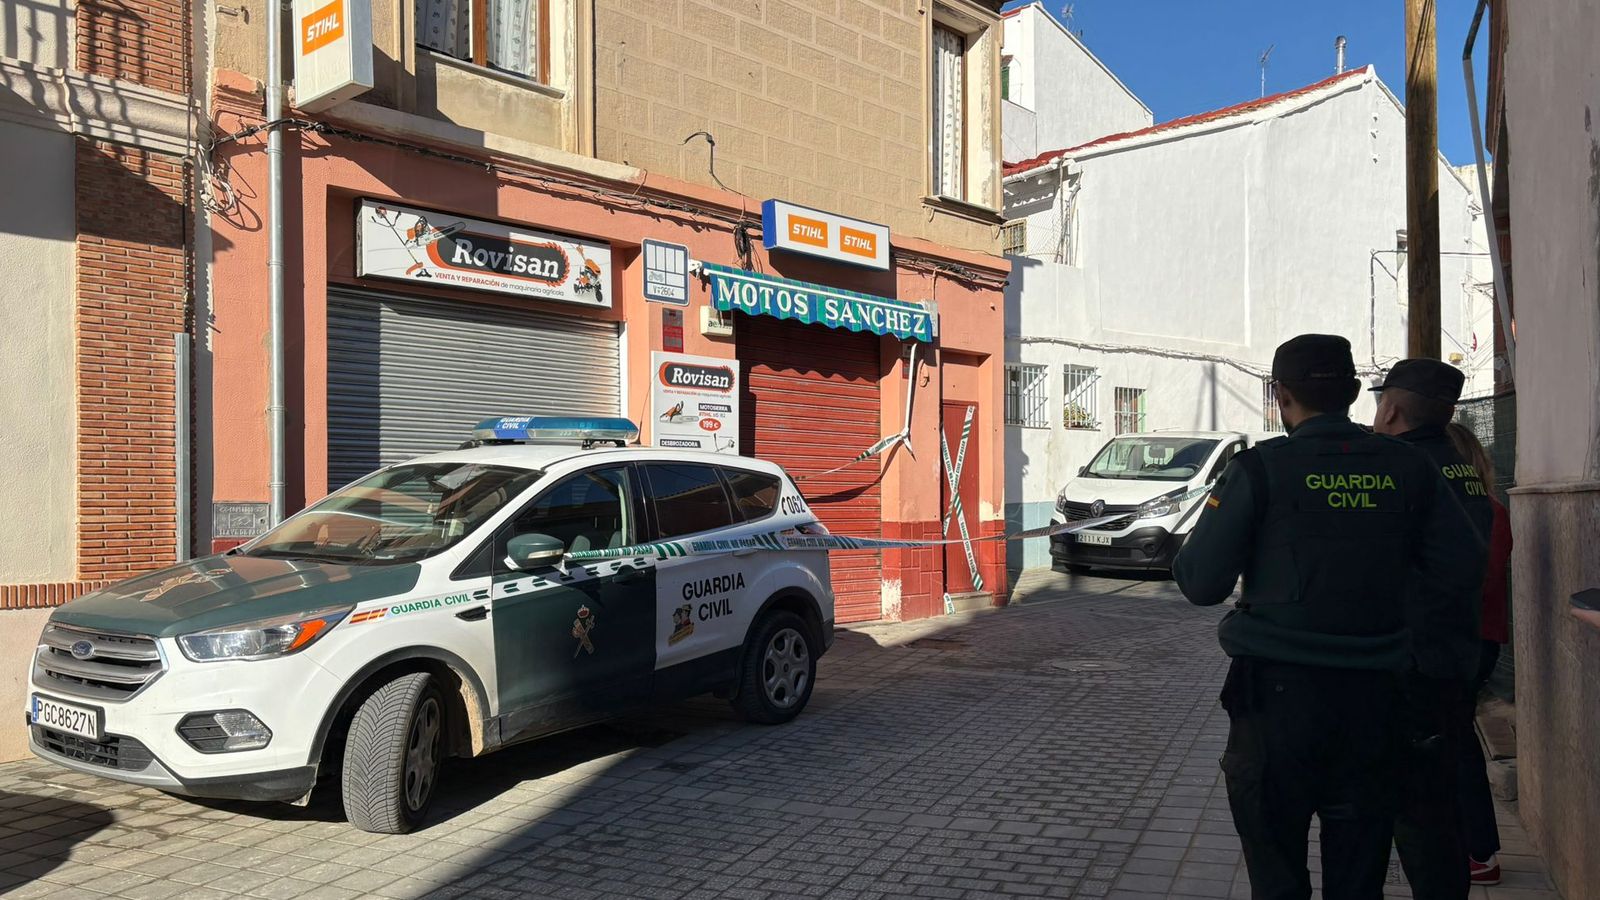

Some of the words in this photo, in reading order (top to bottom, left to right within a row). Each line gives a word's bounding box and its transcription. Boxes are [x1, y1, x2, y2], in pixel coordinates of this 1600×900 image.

[306, 13, 339, 43] STIHL
[792, 223, 824, 240] STIHL
[843, 235, 873, 251] STIHL
[452, 238, 559, 279] Rovisan
[434, 272, 456, 281] VENTA
[461, 276, 501, 288] REPARACIÓN
[501, 281, 509, 289] de
[509, 283, 542, 294] maquinaria
[718, 278, 809, 315] MOTOS
[825, 299, 926, 334] SANCHEZ
[671, 367, 729, 388] Rovisan
[1305, 474, 1396, 490] GUARDIA
[1465, 481, 1487, 496] CIVIL
[786, 495, 806, 515] 062
[1327, 492, 1377, 508] CIVIL
[1079, 534, 1095, 543] 2111
[1096, 536, 1110, 545] KJX
[682, 572, 746, 601] GUARDIA
[390, 598, 442, 615] GUARDIA
[444, 593, 471, 607] CIVIL
[698, 598, 733, 622] CIVIL
[37, 700, 96, 736] PGC8627N
